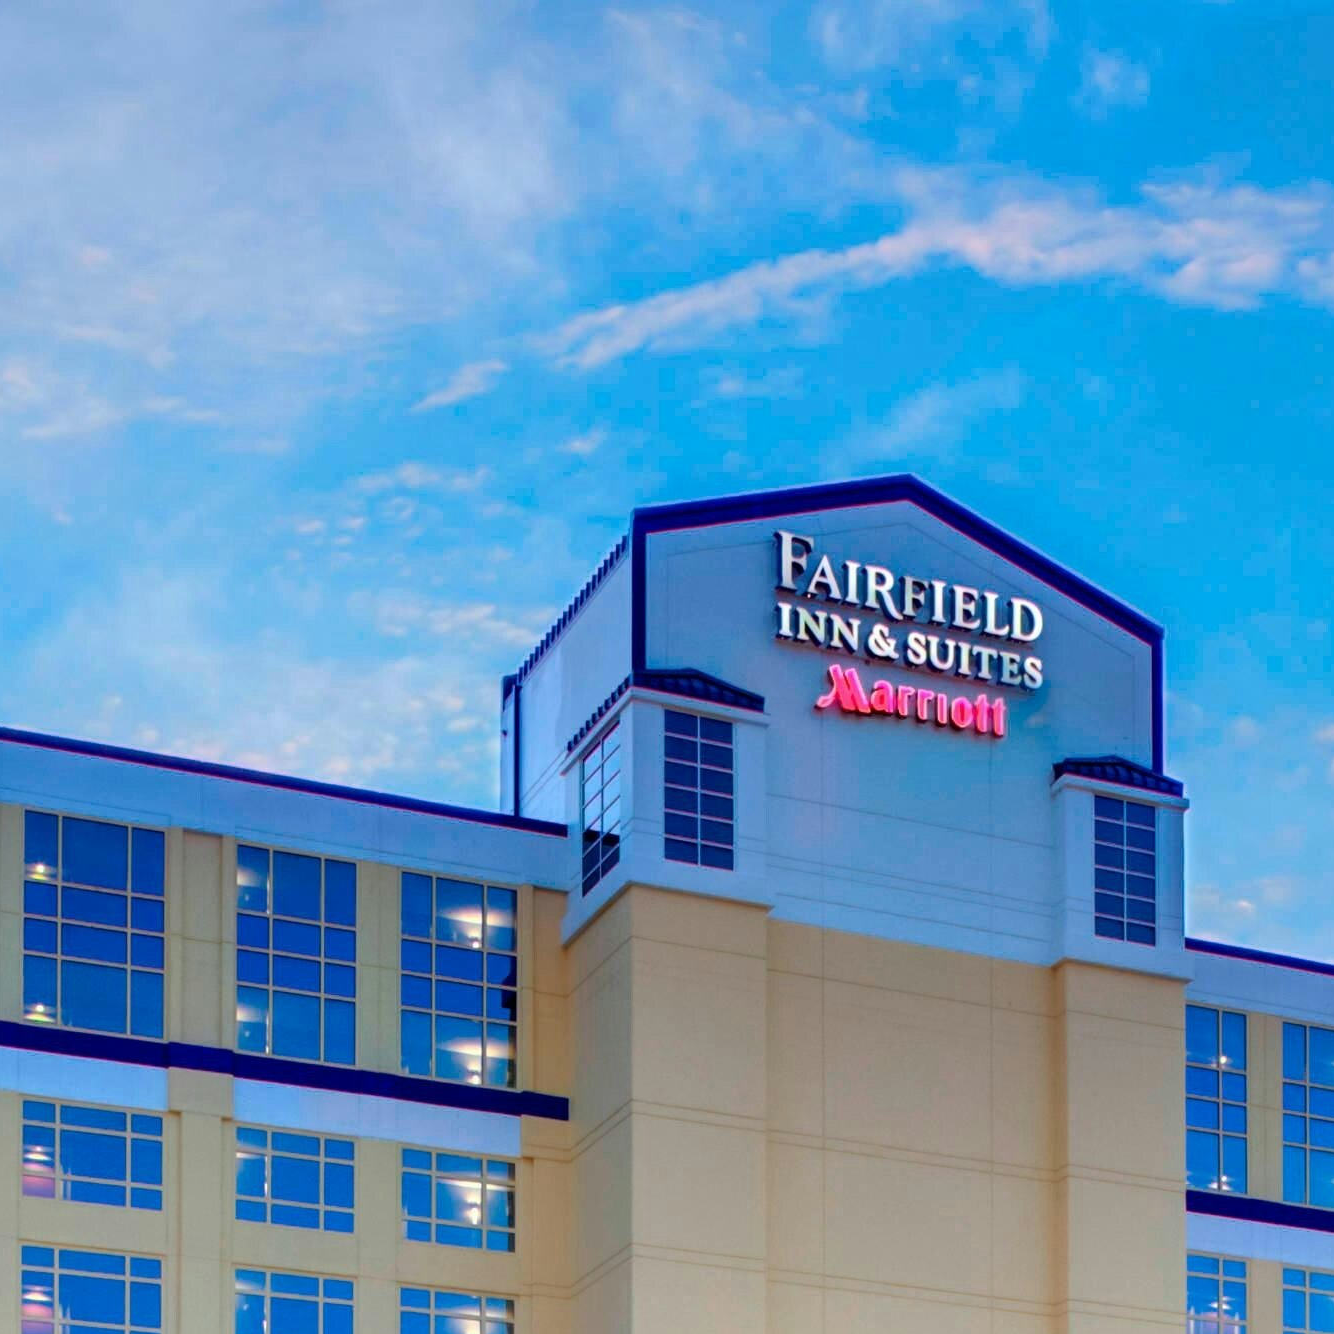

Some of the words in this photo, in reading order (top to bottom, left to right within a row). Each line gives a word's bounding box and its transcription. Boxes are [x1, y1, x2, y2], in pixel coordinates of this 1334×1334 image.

[775, 530, 1044, 642] FAIRFIELD
[776, 602, 861, 651] INN
[867, 623, 900, 660] &
[906, 631, 1044, 690] SUITES
[816, 664, 1006, 737] Marriott
